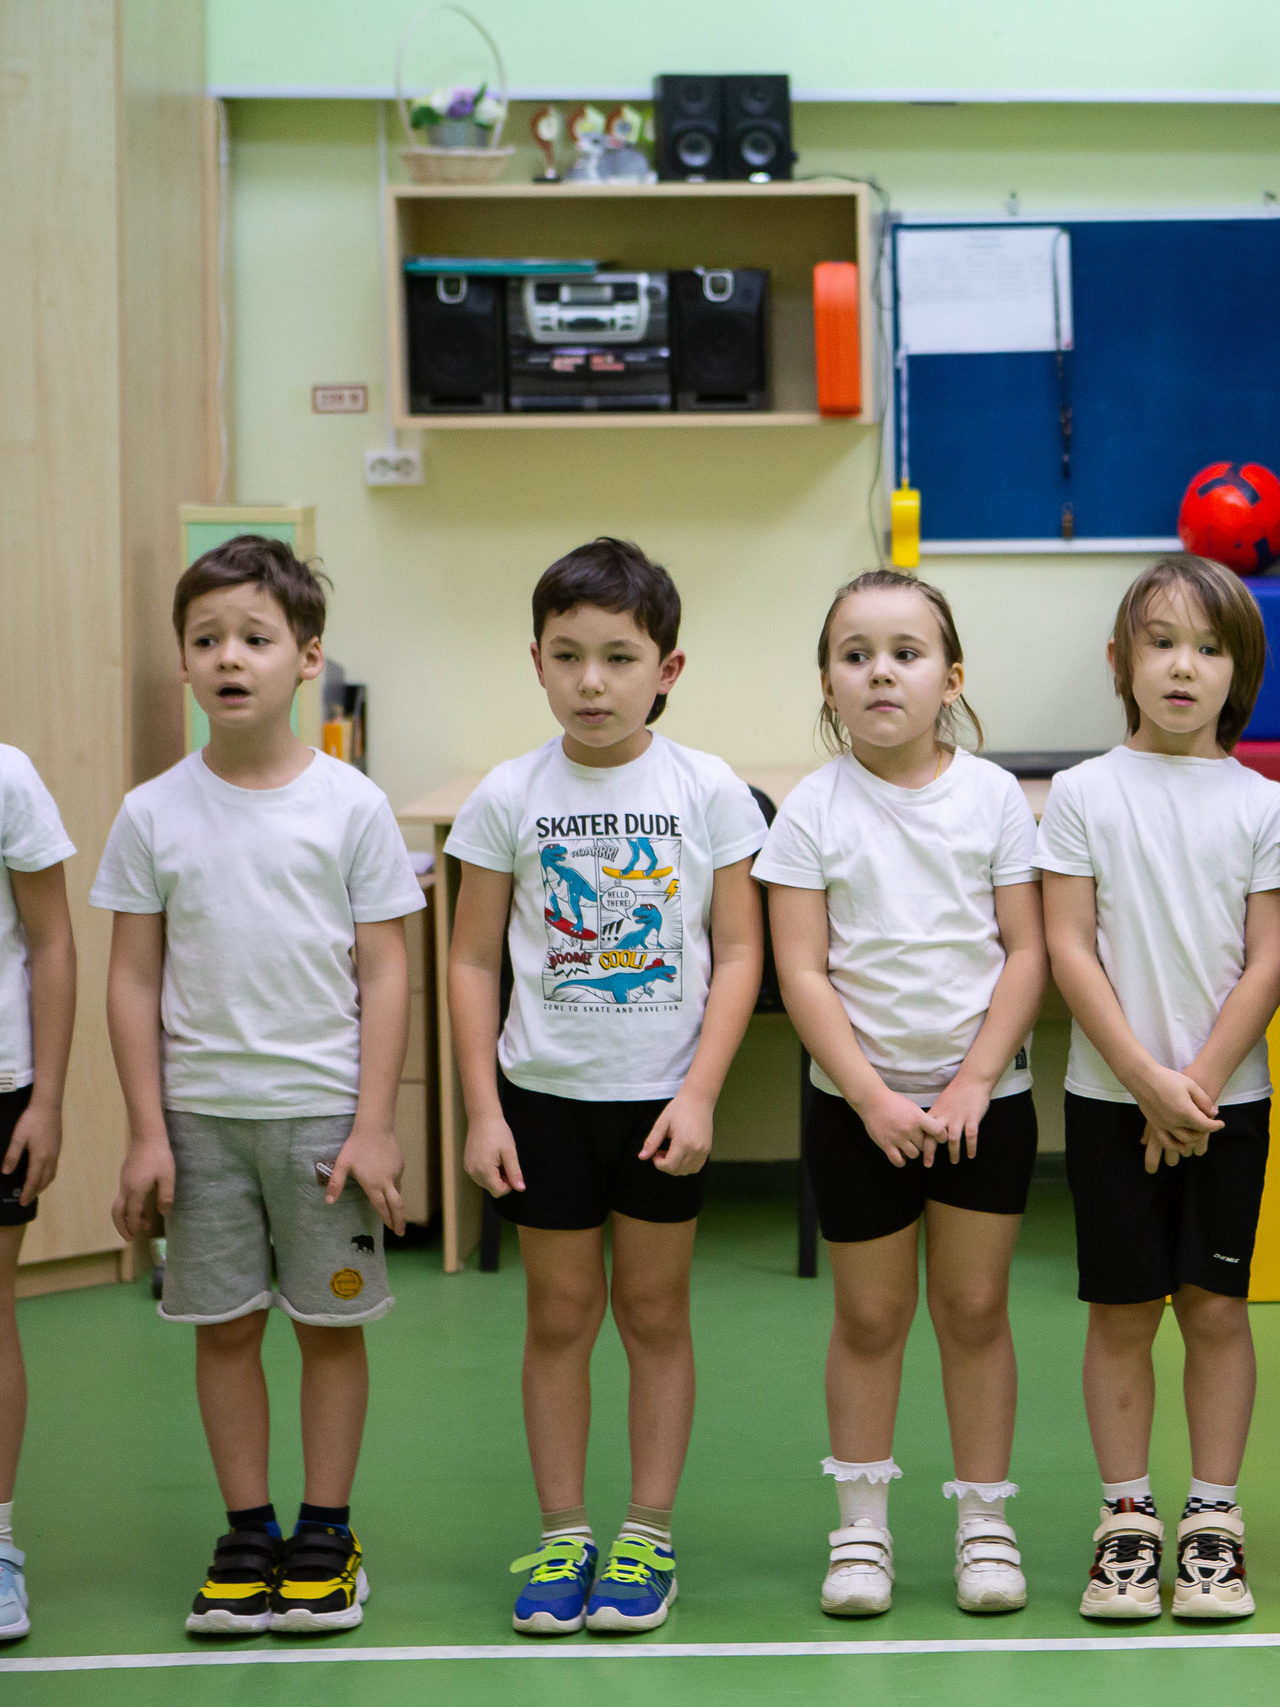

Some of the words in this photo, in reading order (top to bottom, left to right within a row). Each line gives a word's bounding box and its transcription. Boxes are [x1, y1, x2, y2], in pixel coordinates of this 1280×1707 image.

[536, 813, 619, 838] SKATER
[624, 813, 682, 837] DUDE
[599, 950, 647, 970] COOL!
[543, 1003, 564, 1012] COME
[638, 1005, 659, 1013] HAVE
